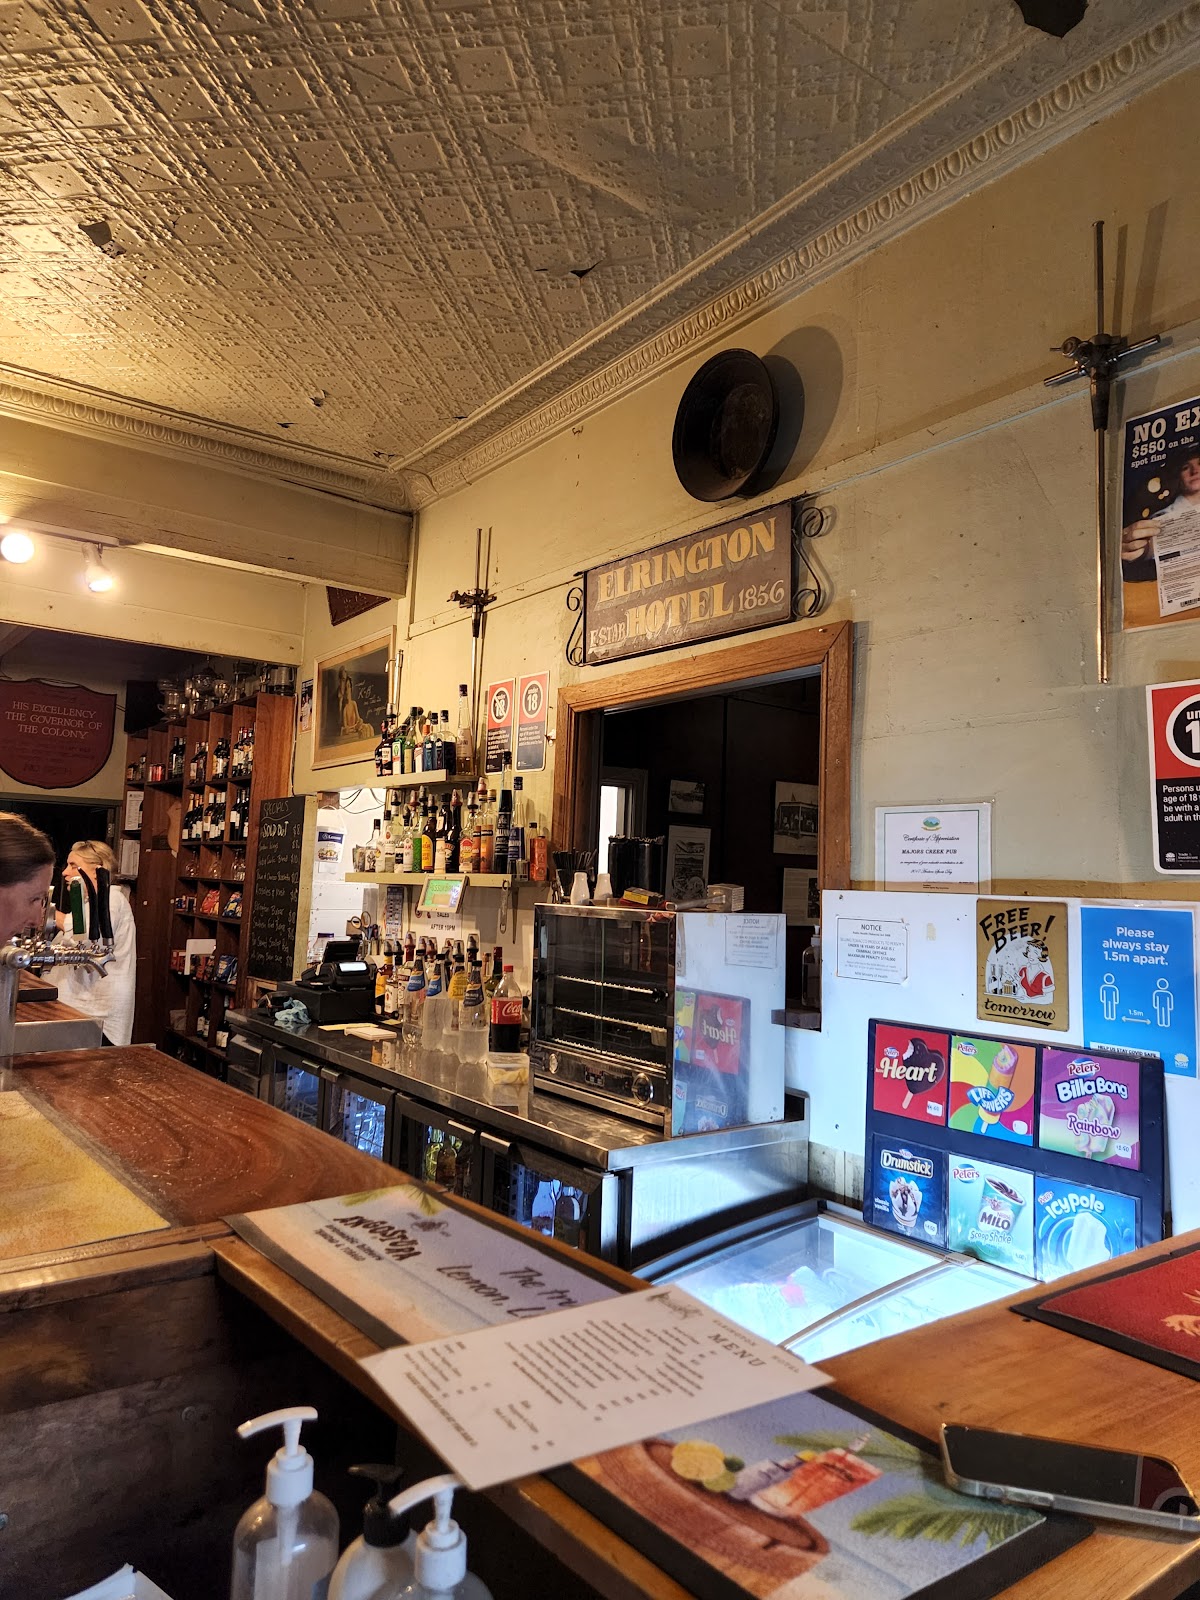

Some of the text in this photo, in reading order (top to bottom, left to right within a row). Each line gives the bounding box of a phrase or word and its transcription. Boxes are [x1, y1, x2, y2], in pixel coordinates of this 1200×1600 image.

[1132, 418, 1167, 444] NO
[1132, 436, 1195, 458] $550 on the
[1131, 453, 1167, 468] spot fine
[597, 516, 777, 604] ELRINGTON
[626, 579, 786, 639] HOTEL 1856
[12, 700, 97, 719] HIS EXCELLENCY
[526, 693, 539, 712] 18
[5, 711, 103, 730] THE GOVERNOR OF
[18, 724, 90, 739] THE COLONY
[1185, 720, 1200, 753] 1
[1162, 784, 1195, 793] Persons
[1163, 793, 1198, 804] age of 18
[1163, 804, 1174, 812] be
[1174, 803, 1192, 812] with
[1164, 813, 1200, 822] adult in th
[903, 834, 925, 843] Certificate
[930, 834, 960, 844] Appreciation
[979, 907, 1031, 941] FREE
[1116, 926, 1155, 938] Please
[990, 915, 1056, 954] BEER!
[1102, 939, 1170, 954] always stay
[1103, 951, 1169, 966] 1.5m apart.
[983, 997, 1057, 1021] tomorrow
[1128, 1009, 1144, 1017] 1.5m
[957, 1043, 977, 1054] Peters
[880, 1057, 938, 1083] Heart
[1067, 1061, 1101, 1076] Peters
[970, 1088, 992, 1103] LIFE
[981, 1086, 1013, 1112] SAVERS
[1067, 1113, 1121, 1139] Rainbow
[882, 1151, 932, 1176] Drumstick
[953, 1167, 980, 1180] Peters
[980, 1211, 1011, 1231] MILO
[333, 1216, 422, 1261] ANGOSTURA
[970, 1230, 1012, 1244] Scoop Shake
[436, 1264, 510, 1307] Lemon,
[499, 1266, 546, 1289] The
[707, 1333, 768, 1367] MENU
